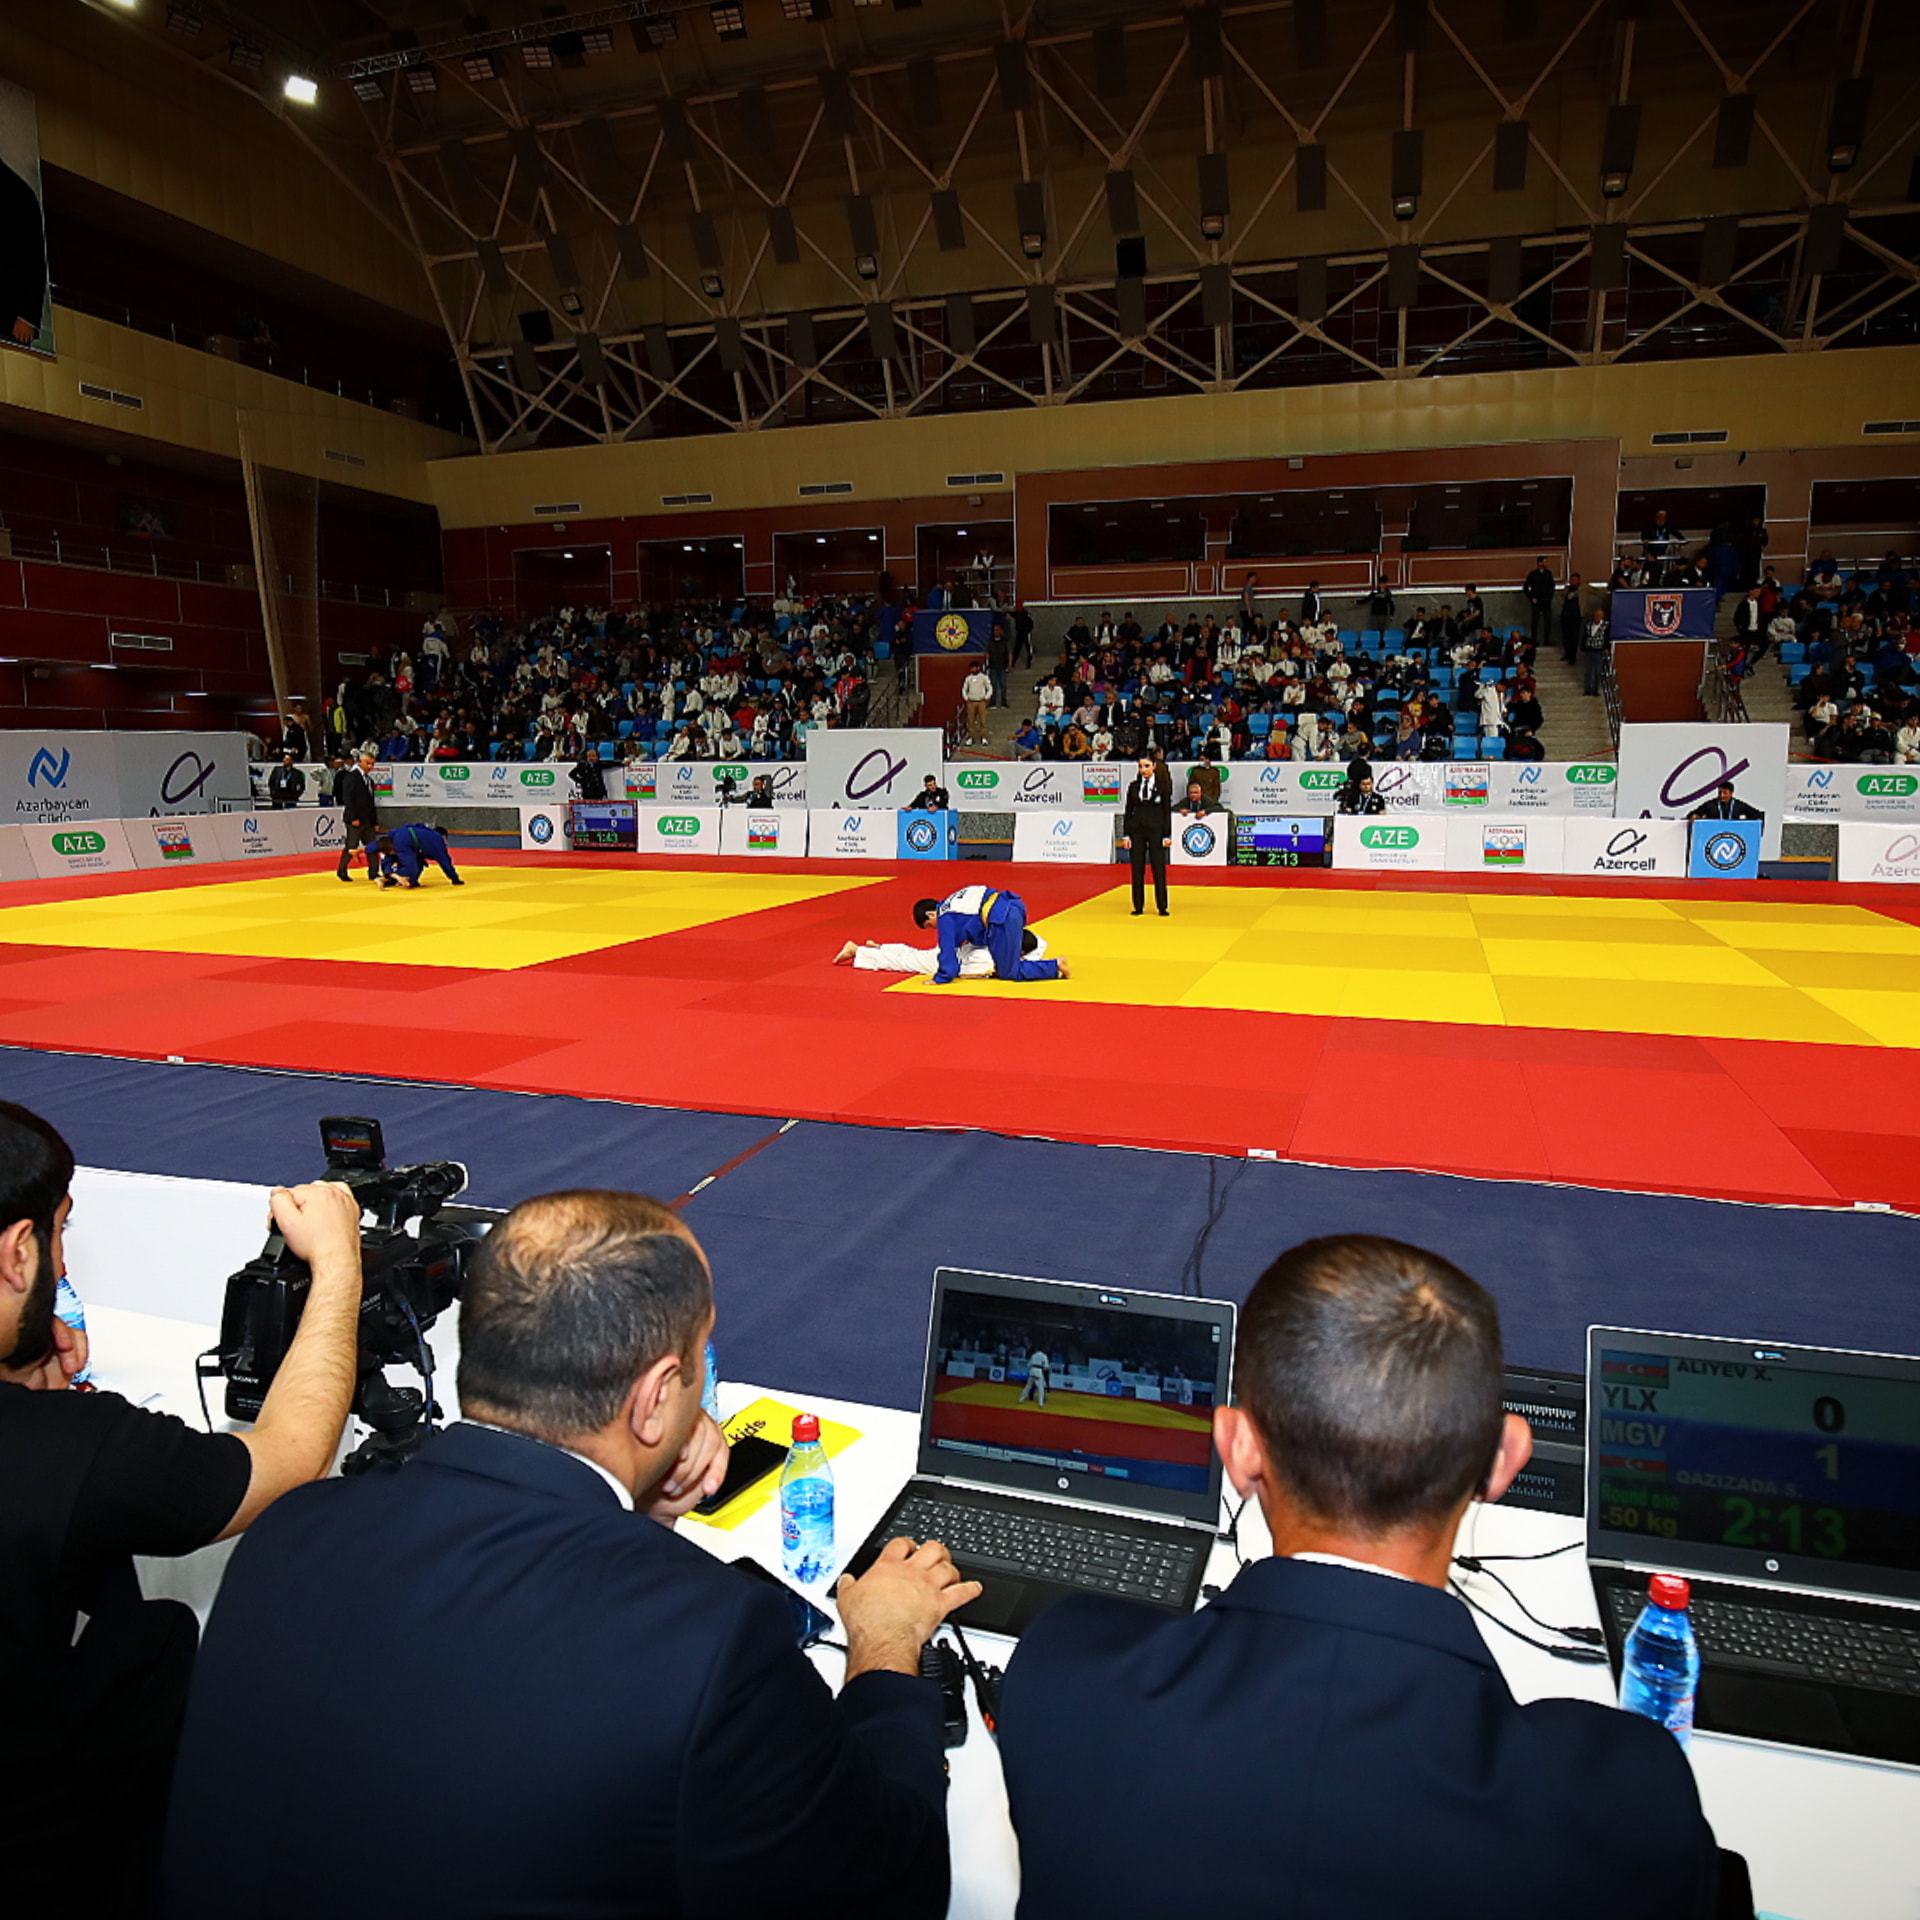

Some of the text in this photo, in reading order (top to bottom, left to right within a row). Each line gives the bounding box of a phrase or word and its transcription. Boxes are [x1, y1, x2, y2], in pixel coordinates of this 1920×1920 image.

[444, 767, 465, 777] AZE
[526, 773, 550, 783] AZE
[963, 774, 992, 785] AZE
[1574, 768, 1608, 782] AZE
[1307, 774, 1340, 787] AZE
[1867, 777, 1908, 793] AZE
[1013, 791, 1062, 804] Azercell
[664, 819, 694, 833] AZE
[63, 836, 97, 852] AZE
[1369, 830, 1409, 846] AZE
[1266, 853, 1299, 866] 2:13
[1593, 857, 1657, 871] Azercell
[1676, 1360, 1774, 1383] ALIYEV X.
[1601, 1385, 1659, 1413] YLX
[1813, 1396, 1845, 1433] 0
[728, 1418, 767, 1443] kids
[1600, 1418, 1668, 1449] MGV
[1816, 1443, 1840, 1481] 1
[1600, 1506, 1680, 1538] -50 kg
[1721, 1496, 1848, 1557] 2:13
